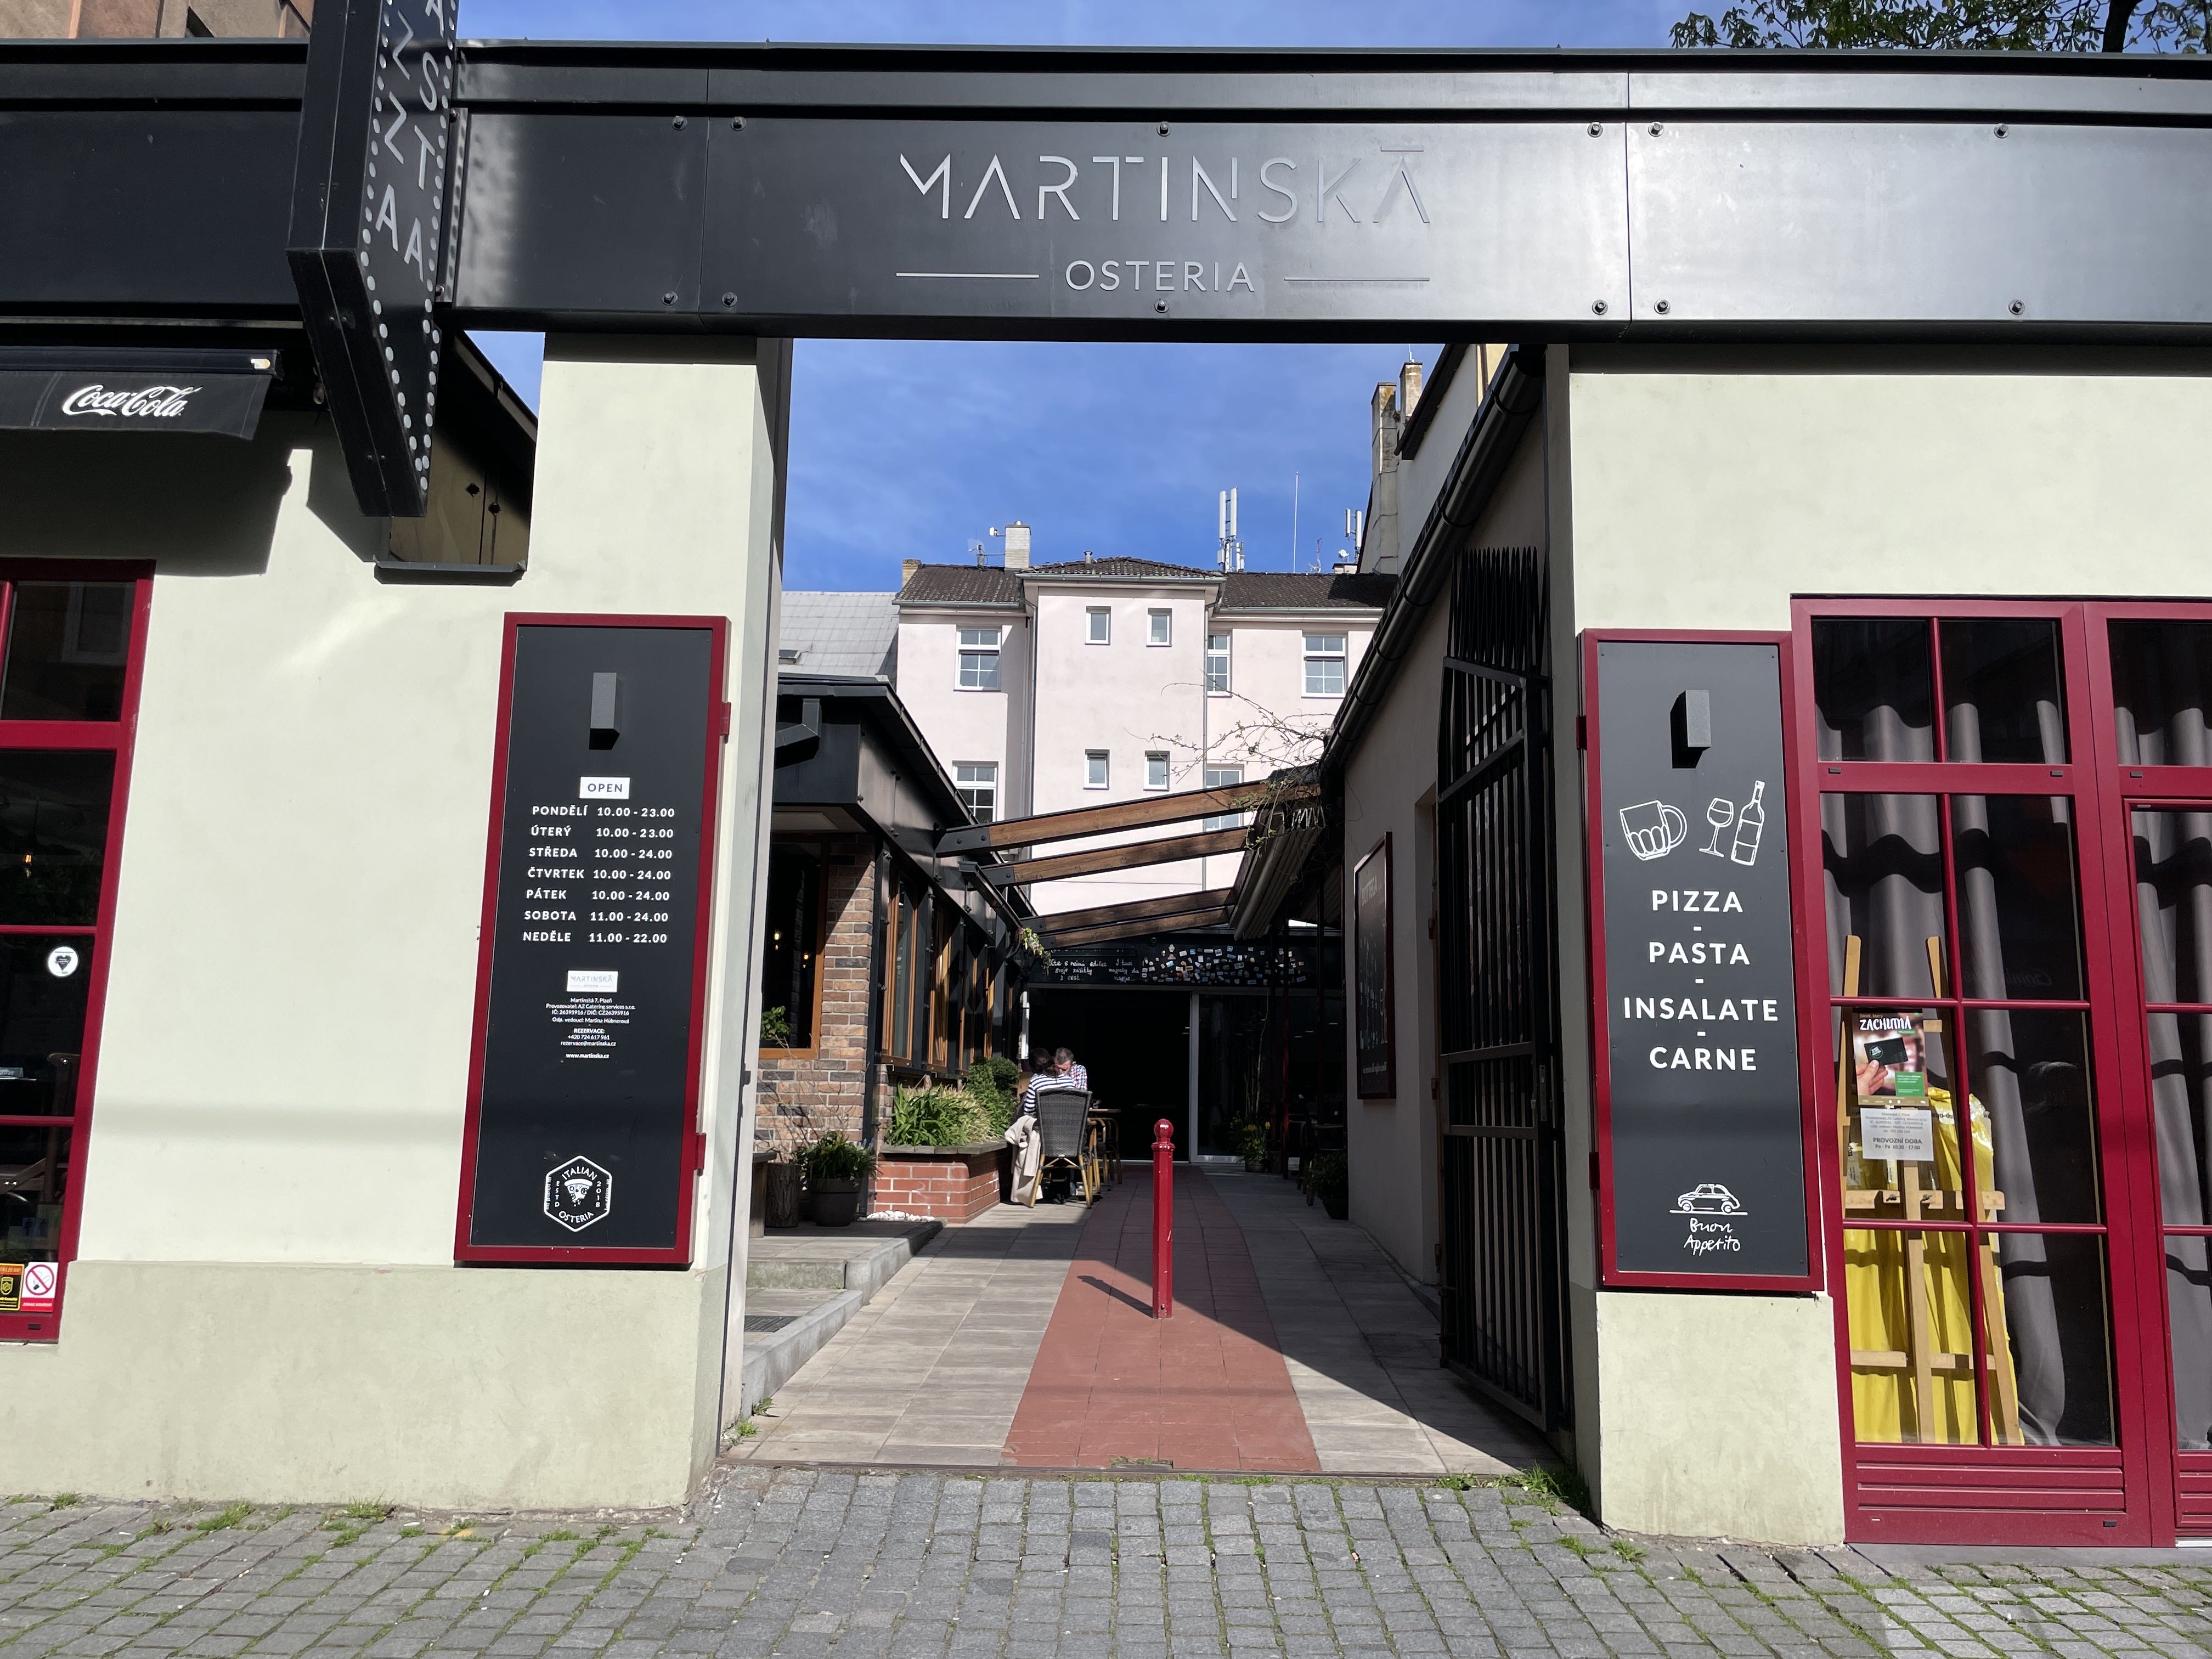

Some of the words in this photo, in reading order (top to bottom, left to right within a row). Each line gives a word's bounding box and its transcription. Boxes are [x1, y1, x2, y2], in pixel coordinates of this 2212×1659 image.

[1065, 261, 1255, 292] OSTERIA
[588, 783, 623, 793] OPEN
[532, 804, 588, 816] PONDĚLÍ
[597, 807, 630, 817] 10.00
[641, 808, 675, 817] 23.00
[531, 824, 572, 837] ÚTERÝ
[596, 827, 629, 838] 10.00
[640, 828, 674, 838] 23.00
[529, 845, 578, 857] STŘEDA
[595, 848, 628, 859] 10.00
[638, 849, 673, 859] 24.00
[528, 866, 584, 879] ČTVRTEK
[593, 869, 627, 879] 10.00
[637, 870, 671, 880] 24.00
[526, 887, 567, 899] PÁTEK
[592, 890, 625, 900] 10.00
[635, 890, 670, 901] 24.00
[1652, 890, 1743, 912] PIZZA
[524, 910, 577, 921] SOBOTA
[590, 911, 624, 922] 11.00
[634, 912, 668, 922] 24.00
[523, 930, 571, 942] NEDĚLE
[589, 933, 623, 943] 11.00
[633, 933, 667, 943] 22.00
[1649, 941, 1750, 965] PASTA
[1624, 997, 1778, 1022] INSALATE
[1650, 1047, 1757, 1070] CARNE
[562, 1166, 597, 1180] ITALIAN
[559, 1211, 594, 1222] OSTERIA
[1689, 1217, 1735, 1235] Buon
[1683, 1234, 1741, 1256] Appetito
